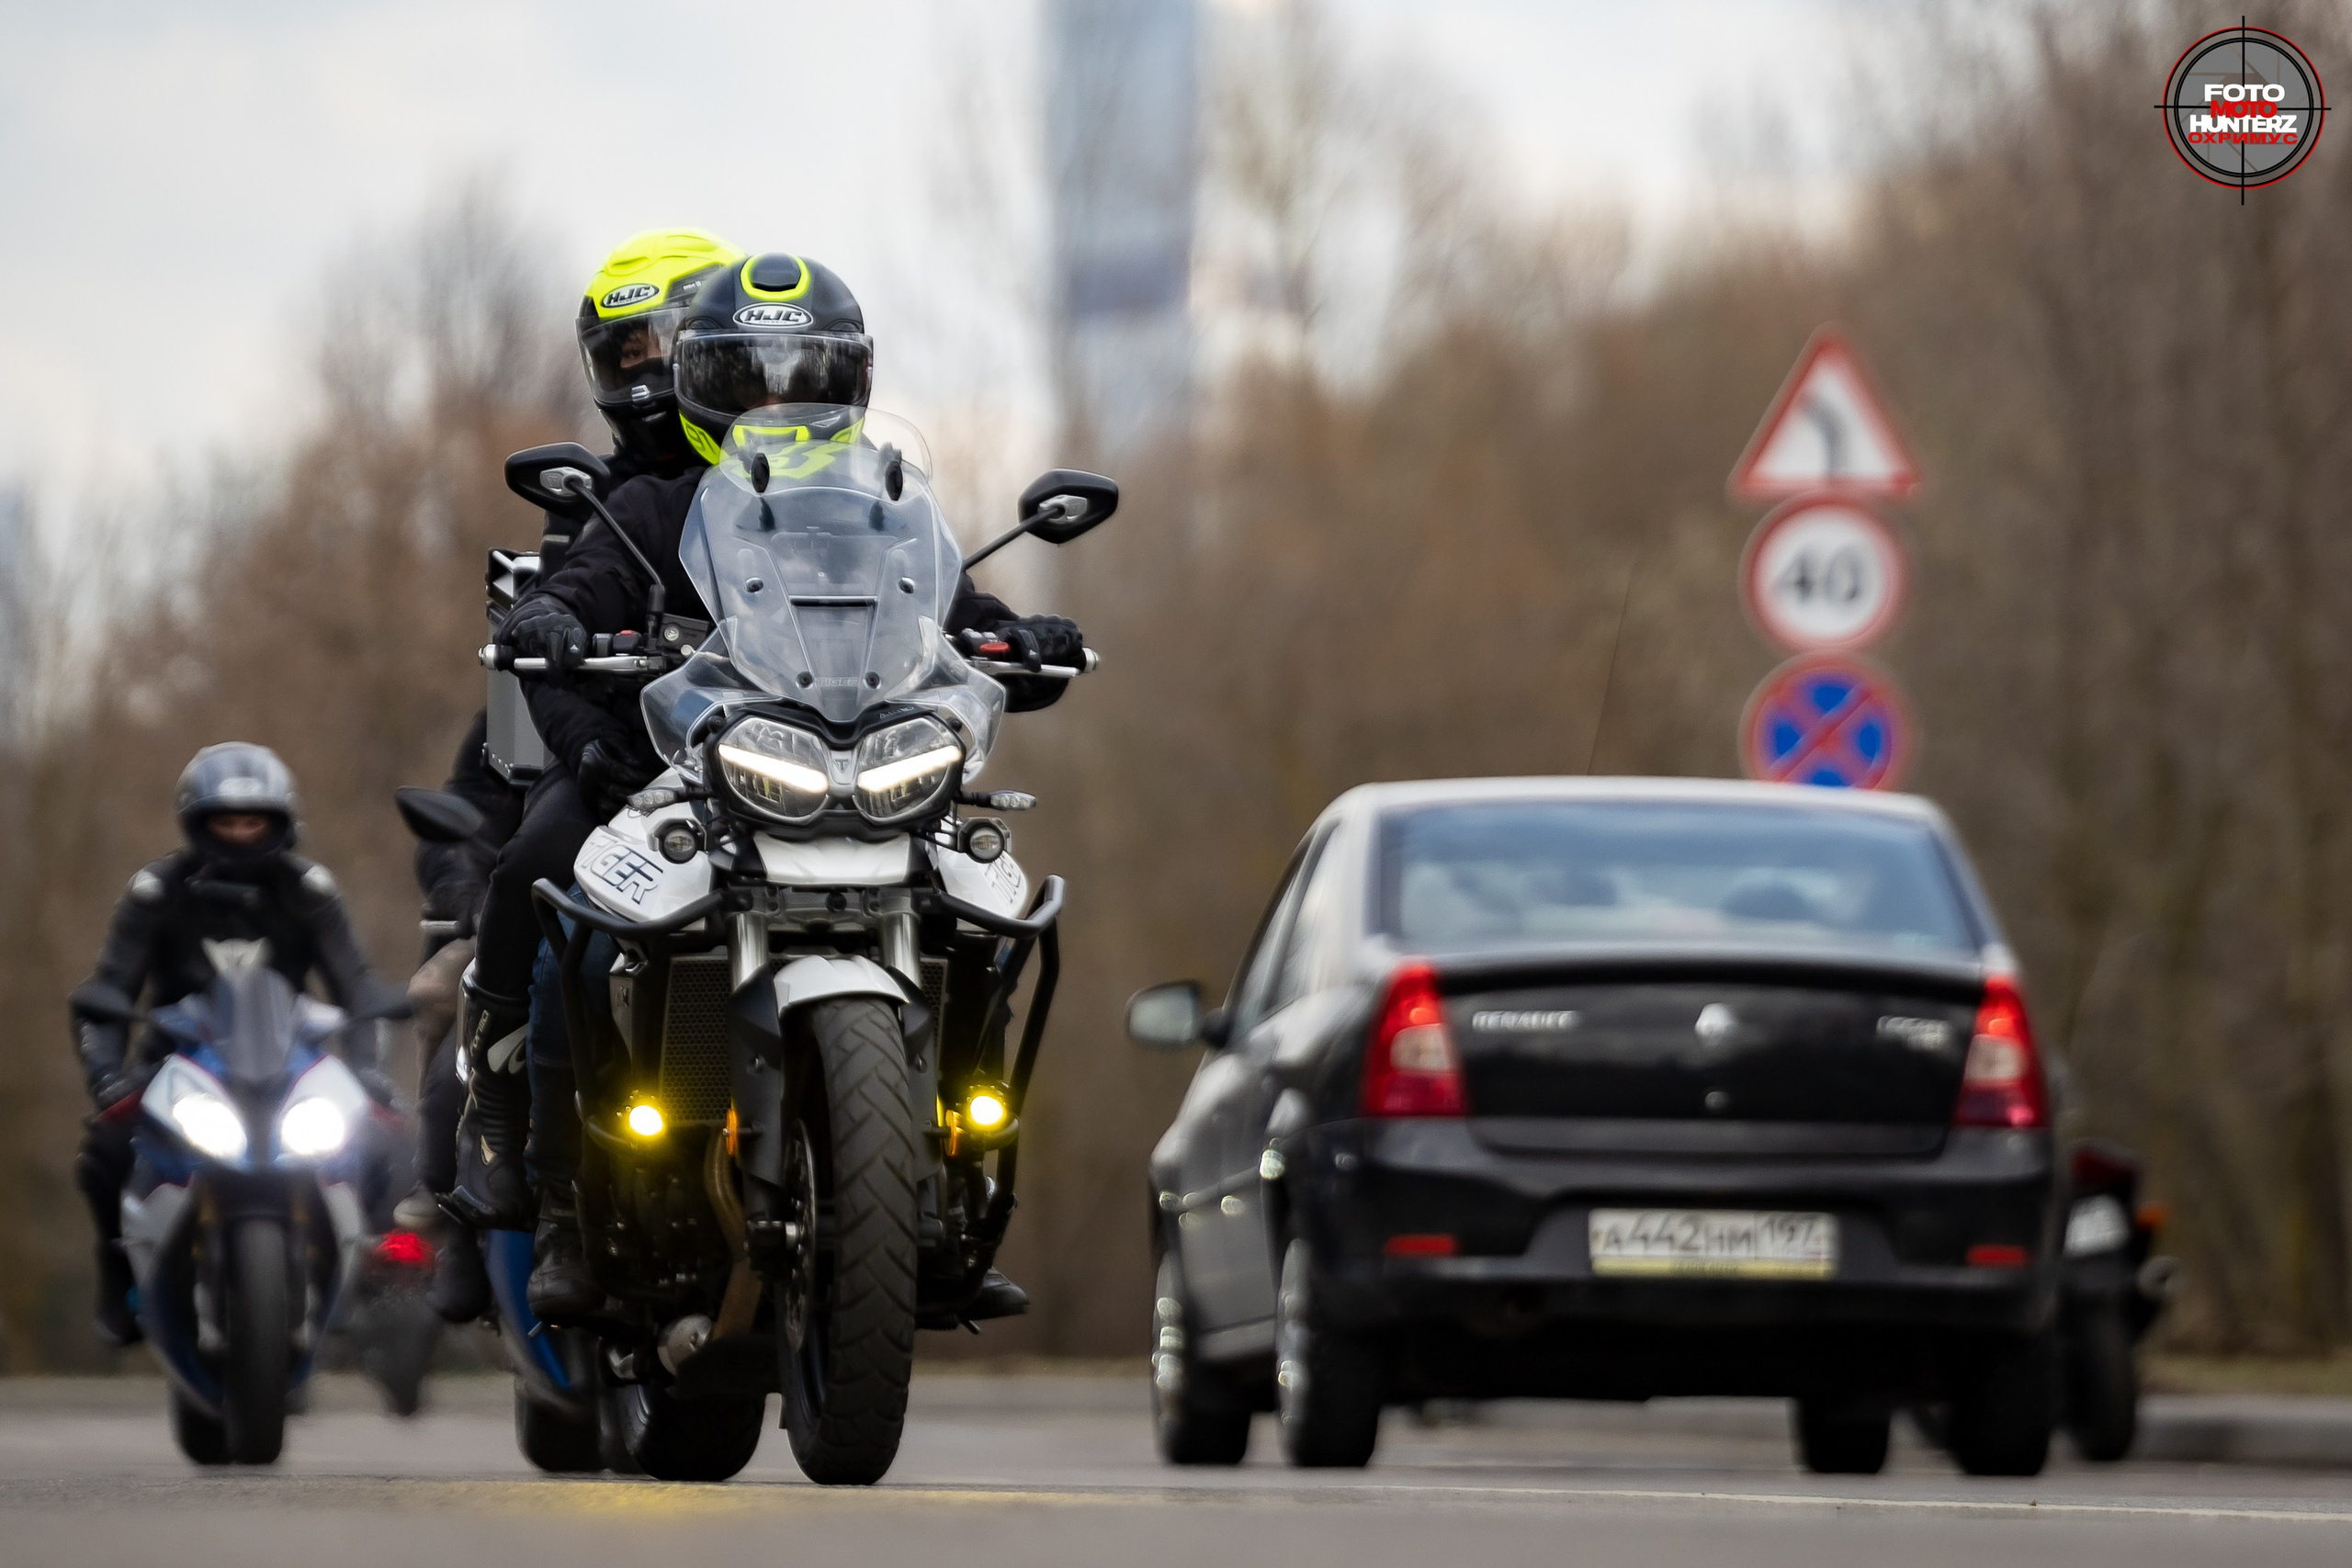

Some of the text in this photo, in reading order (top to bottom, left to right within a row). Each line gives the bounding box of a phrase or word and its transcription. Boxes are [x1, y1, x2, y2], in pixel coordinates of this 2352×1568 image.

[606, 286, 650, 305] HJC
[744, 310, 803, 322] HJC
[1772, 543, 1866, 615] 40
[580, 834, 663, 905] TIGER
